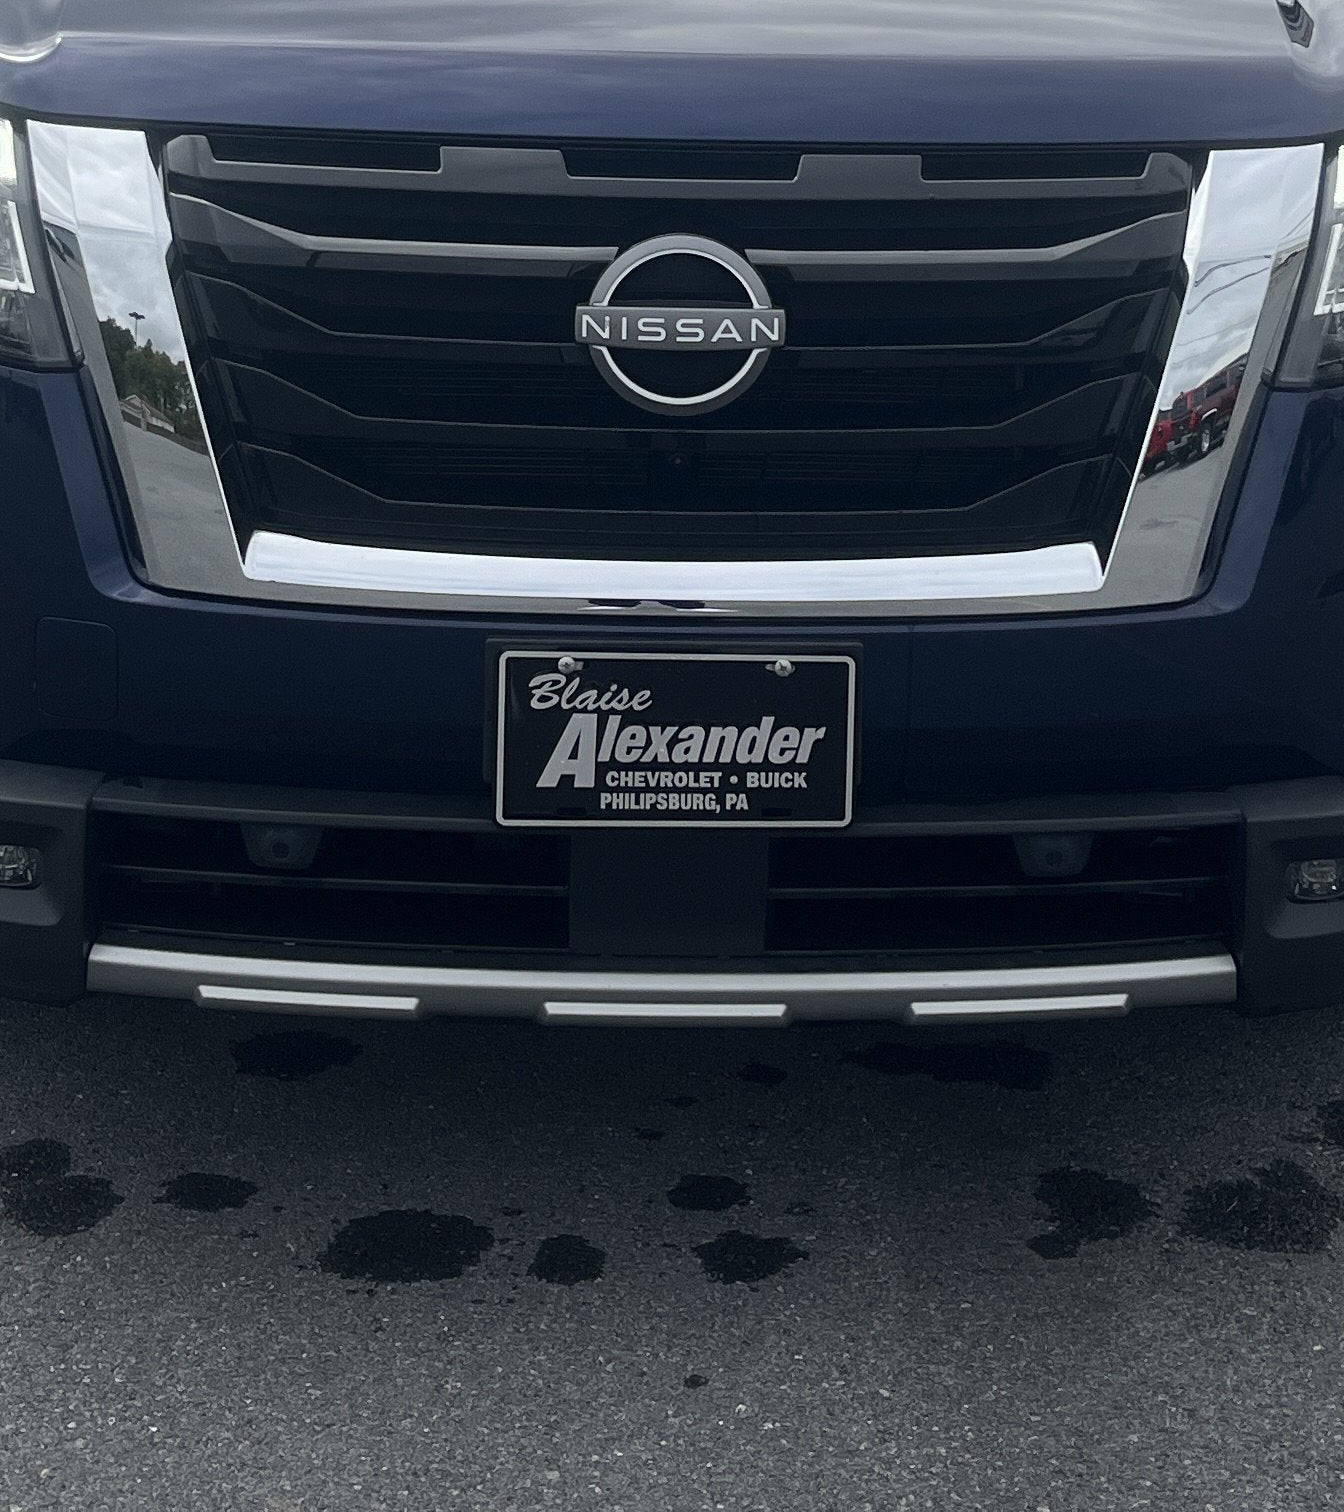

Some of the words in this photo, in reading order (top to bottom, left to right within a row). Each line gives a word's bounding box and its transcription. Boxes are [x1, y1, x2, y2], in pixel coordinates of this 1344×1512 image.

[581, 313, 780, 343] NISSAN
[528, 671, 654, 712] Blaise
[535, 713, 827, 788] Alexander
[605, 771, 723, 788] CHEVROLET
[746, 772, 808, 788] BUICK
[599, 792, 721, 813] PHILIPSBURG,
[725, 793, 749, 811] PA
